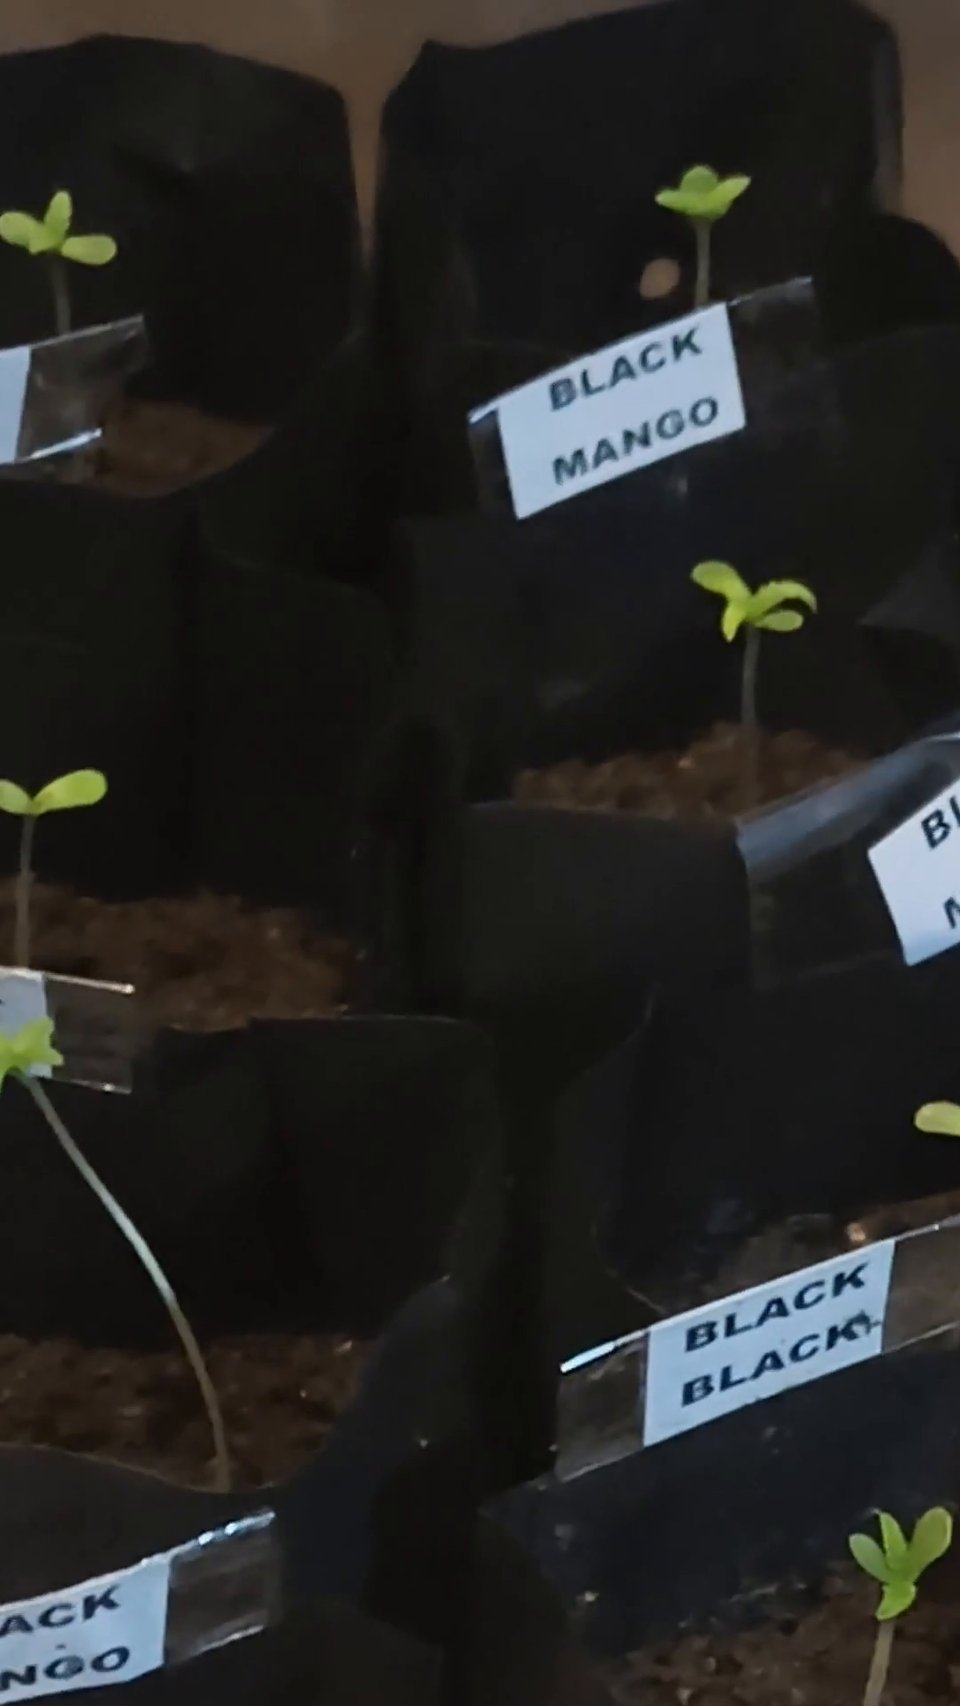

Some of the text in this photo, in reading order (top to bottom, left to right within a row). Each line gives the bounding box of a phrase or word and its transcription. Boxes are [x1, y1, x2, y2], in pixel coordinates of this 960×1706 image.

[549, 327, 703, 411] BLACK
[552, 397, 719, 485] MANGO
[685, 1262, 869, 1352] BLACK
